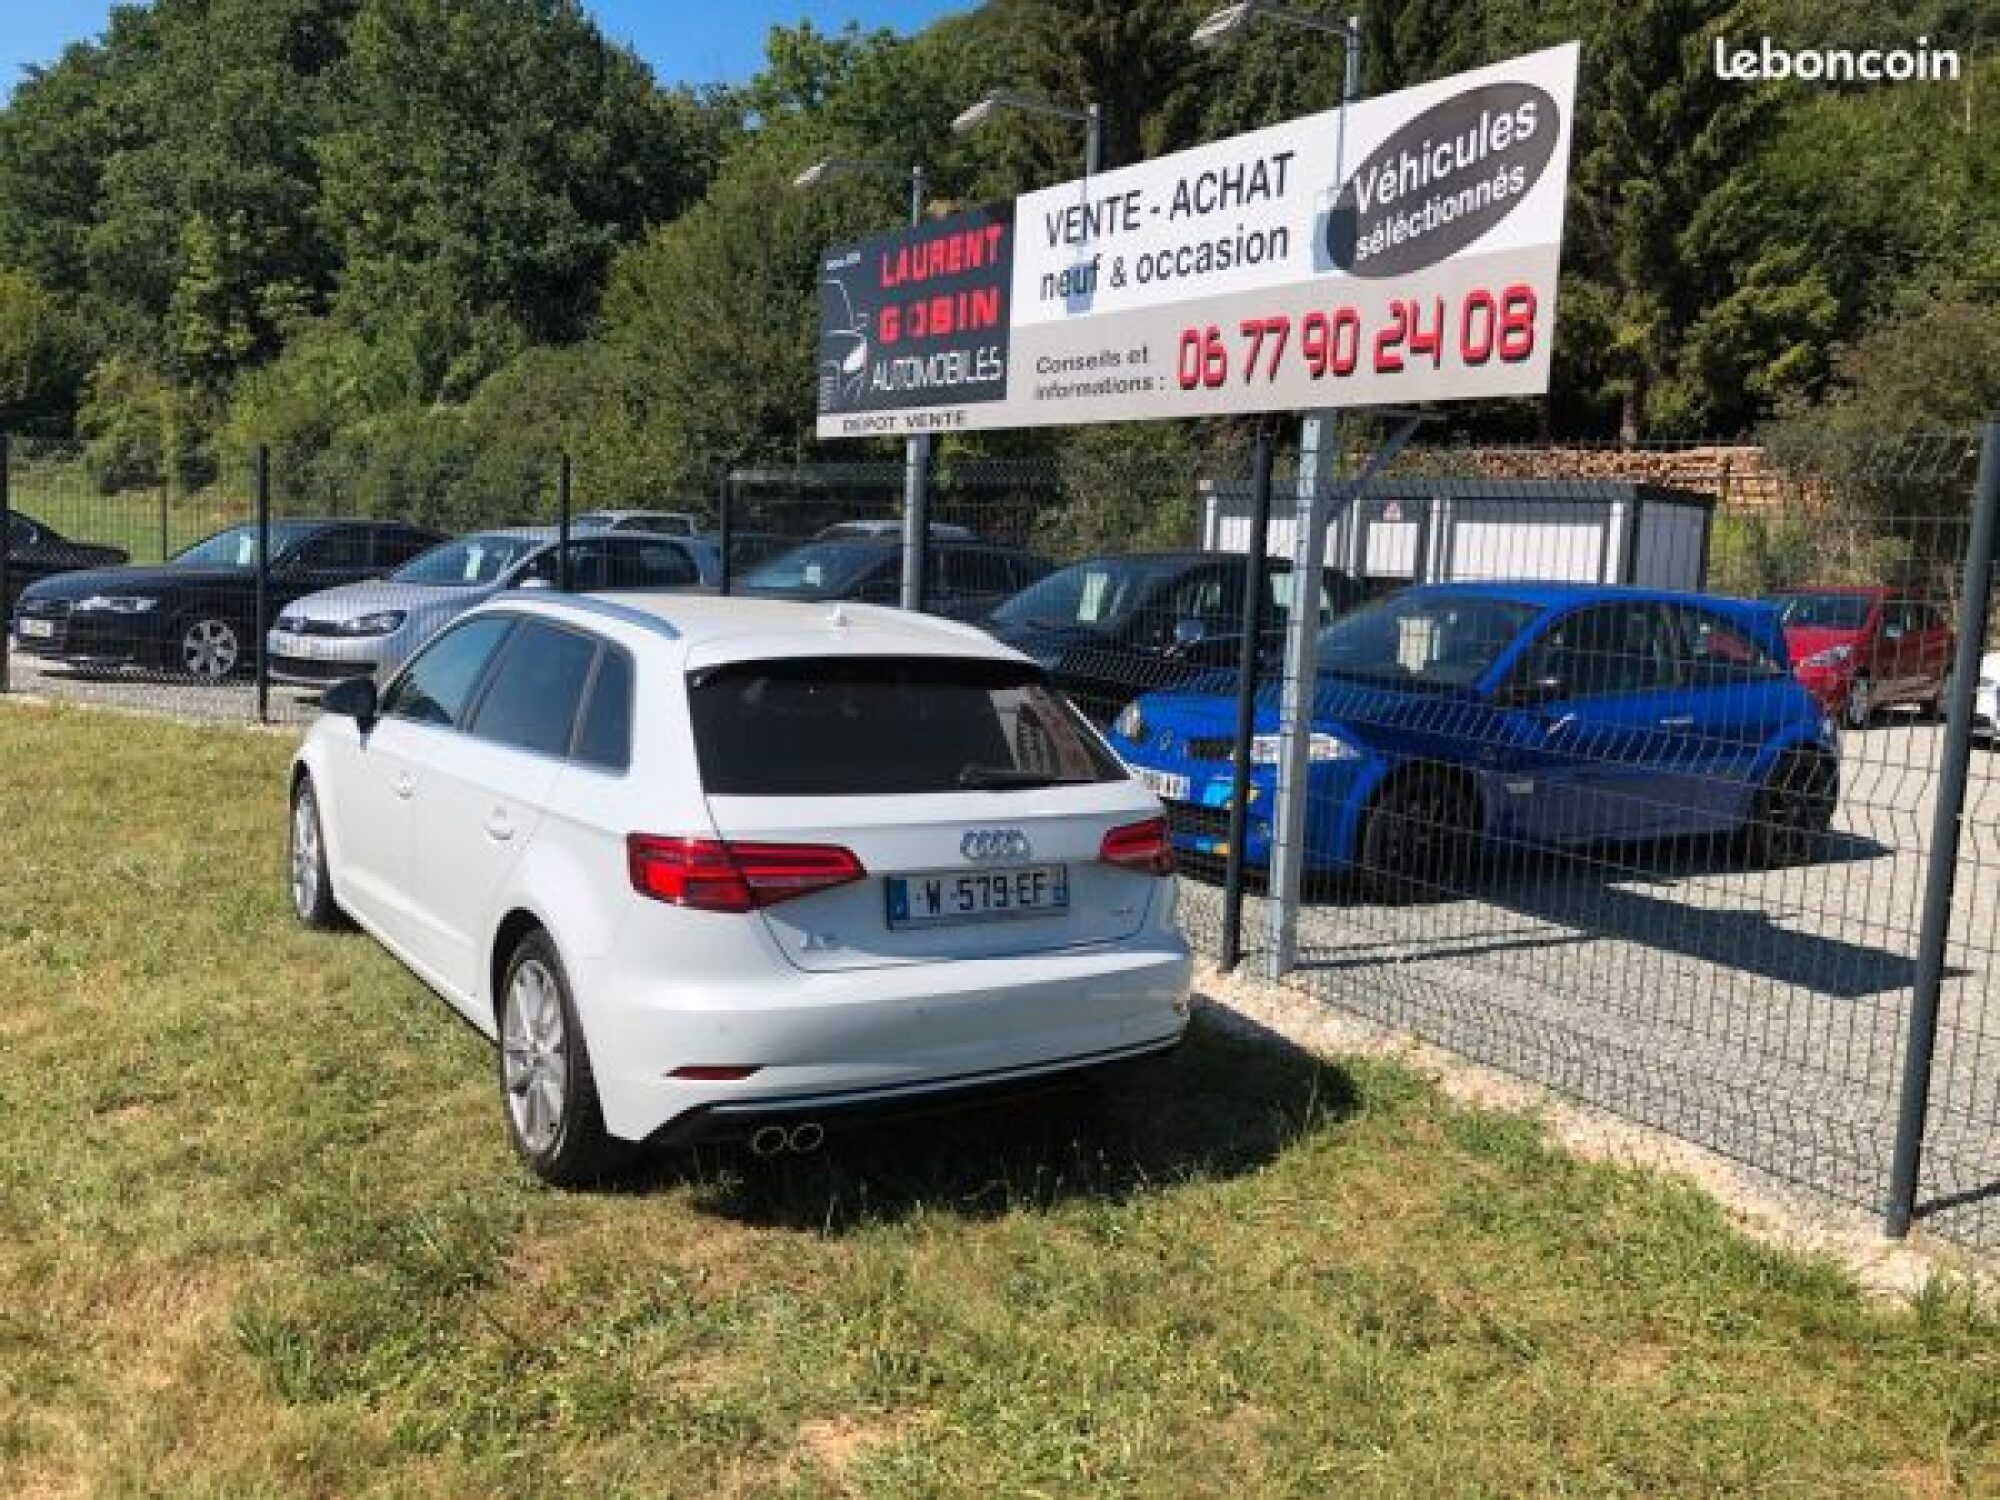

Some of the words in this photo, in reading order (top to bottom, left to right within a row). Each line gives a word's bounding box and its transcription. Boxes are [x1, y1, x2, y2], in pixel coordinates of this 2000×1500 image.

[1354, 101, 1539, 214] Véhicules
[1045, 189, 1141, 247] VENTE
[1169, 151, 1295, 222] ACHAT
[880, 224, 1002, 286] LAURENT
[1040, 252, 1101, 300] neuf
[1109, 255, 1127, 288] &
[1136, 224, 1289, 283] occasion
[877, 287, 998, 343] GOBIN
[1177, 325, 1228, 391] 06
[1240, 315, 1290, 383] 77
[1301, 305, 1361, 378] 90
[1373, 294, 1444, 374] 24
[1459, 283, 1537, 366] 08
[870, 345, 1002, 392] AUTOMOBILES
[1036, 349, 1121, 374] Conseils
[1127, 343, 1149, 365] et
[904, 409, 967, 430] VENTE
